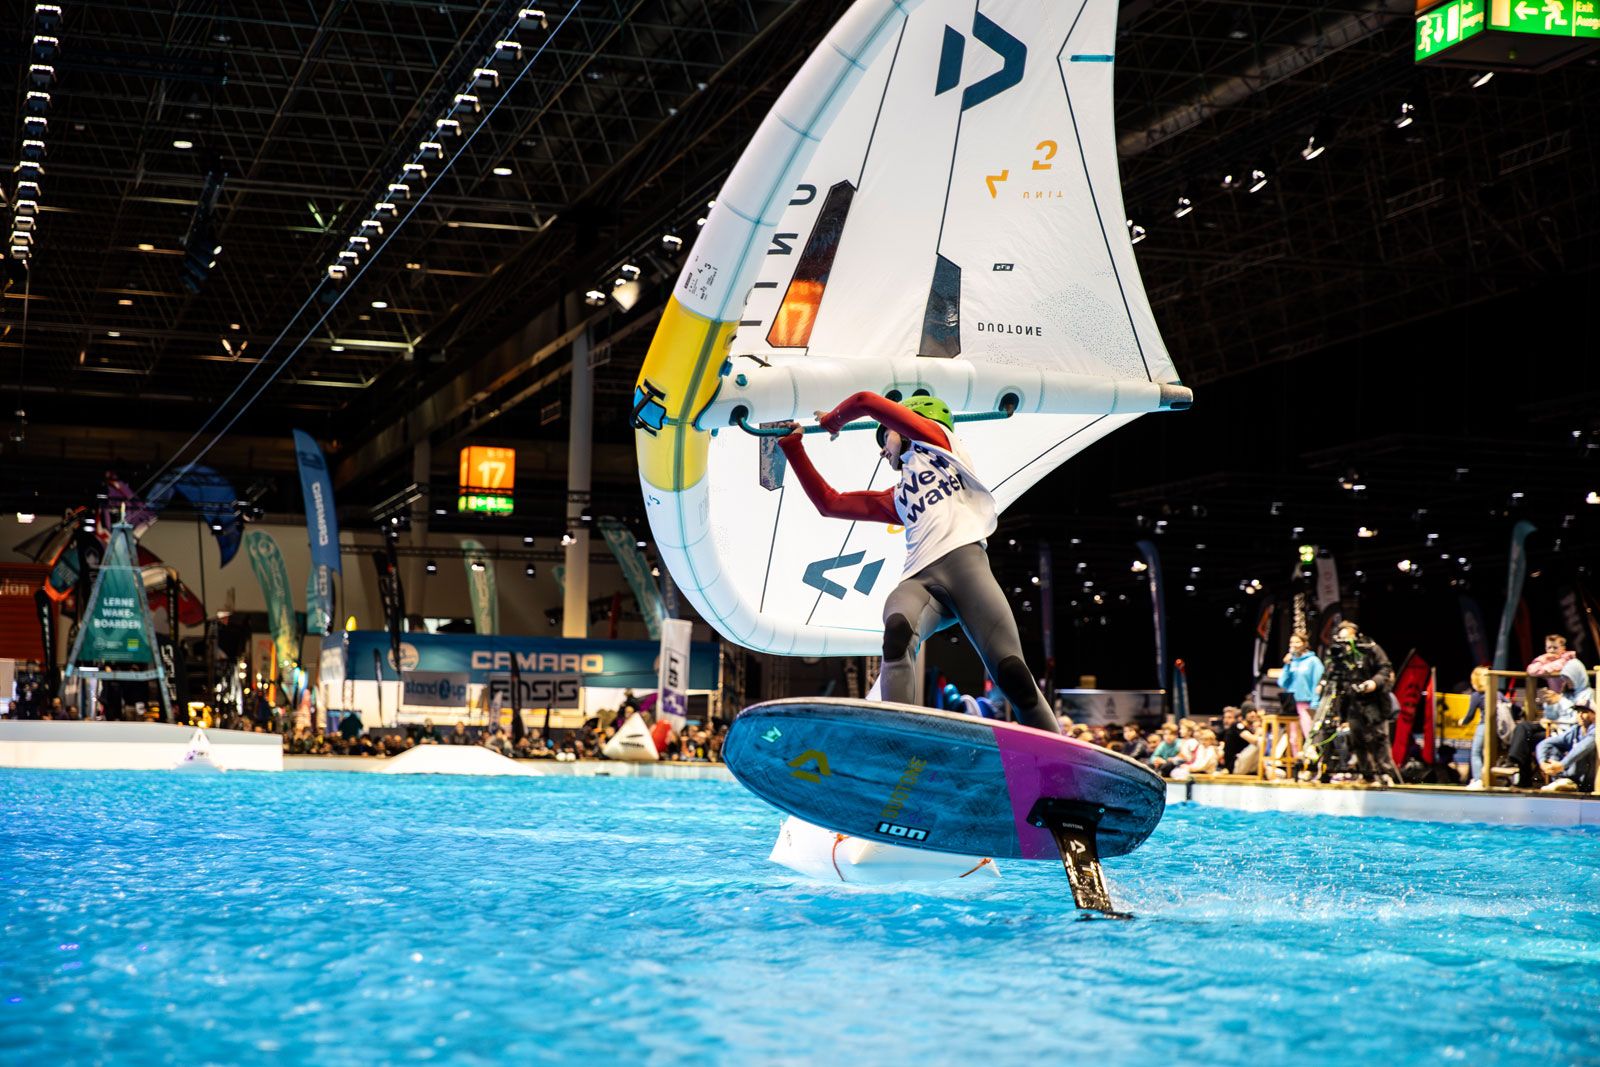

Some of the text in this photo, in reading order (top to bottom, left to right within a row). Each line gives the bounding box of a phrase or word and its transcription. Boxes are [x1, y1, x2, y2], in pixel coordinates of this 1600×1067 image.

[478, 461, 506, 488] 17
[0, 579, 30, 596] ion
[103, 597, 135, 608] LERNE
[102, 608, 134, 618] WAKE-
[94, 618, 142, 629] BOARDEN
[471, 651, 604, 673] CAMARO
[881, 756, 928, 819] DUOTONE
